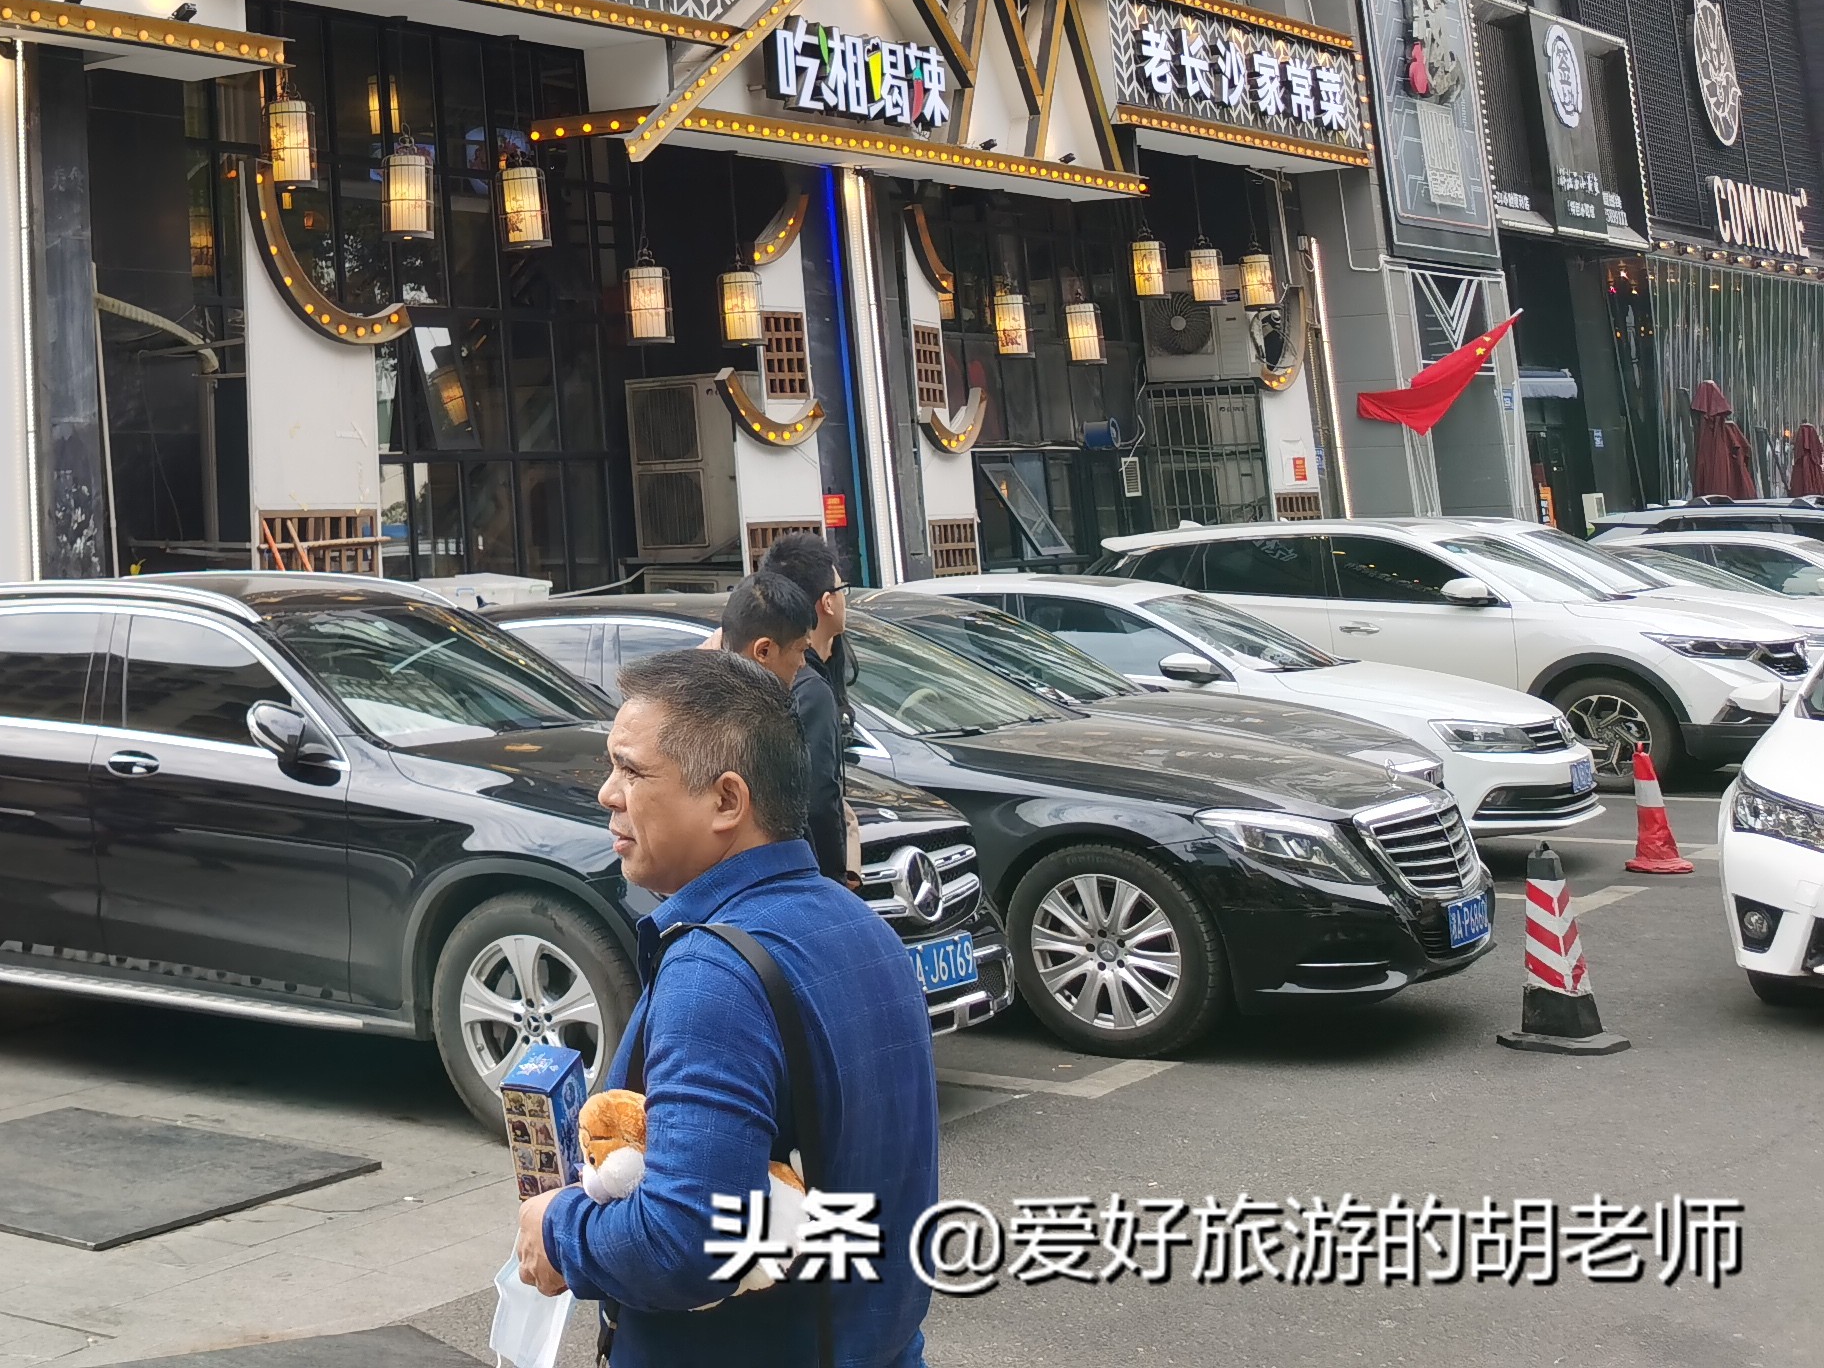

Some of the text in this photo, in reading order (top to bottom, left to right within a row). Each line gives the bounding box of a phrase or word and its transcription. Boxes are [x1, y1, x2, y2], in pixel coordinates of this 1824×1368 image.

[1141, 23, 1346, 130] 老长沙家常菜
